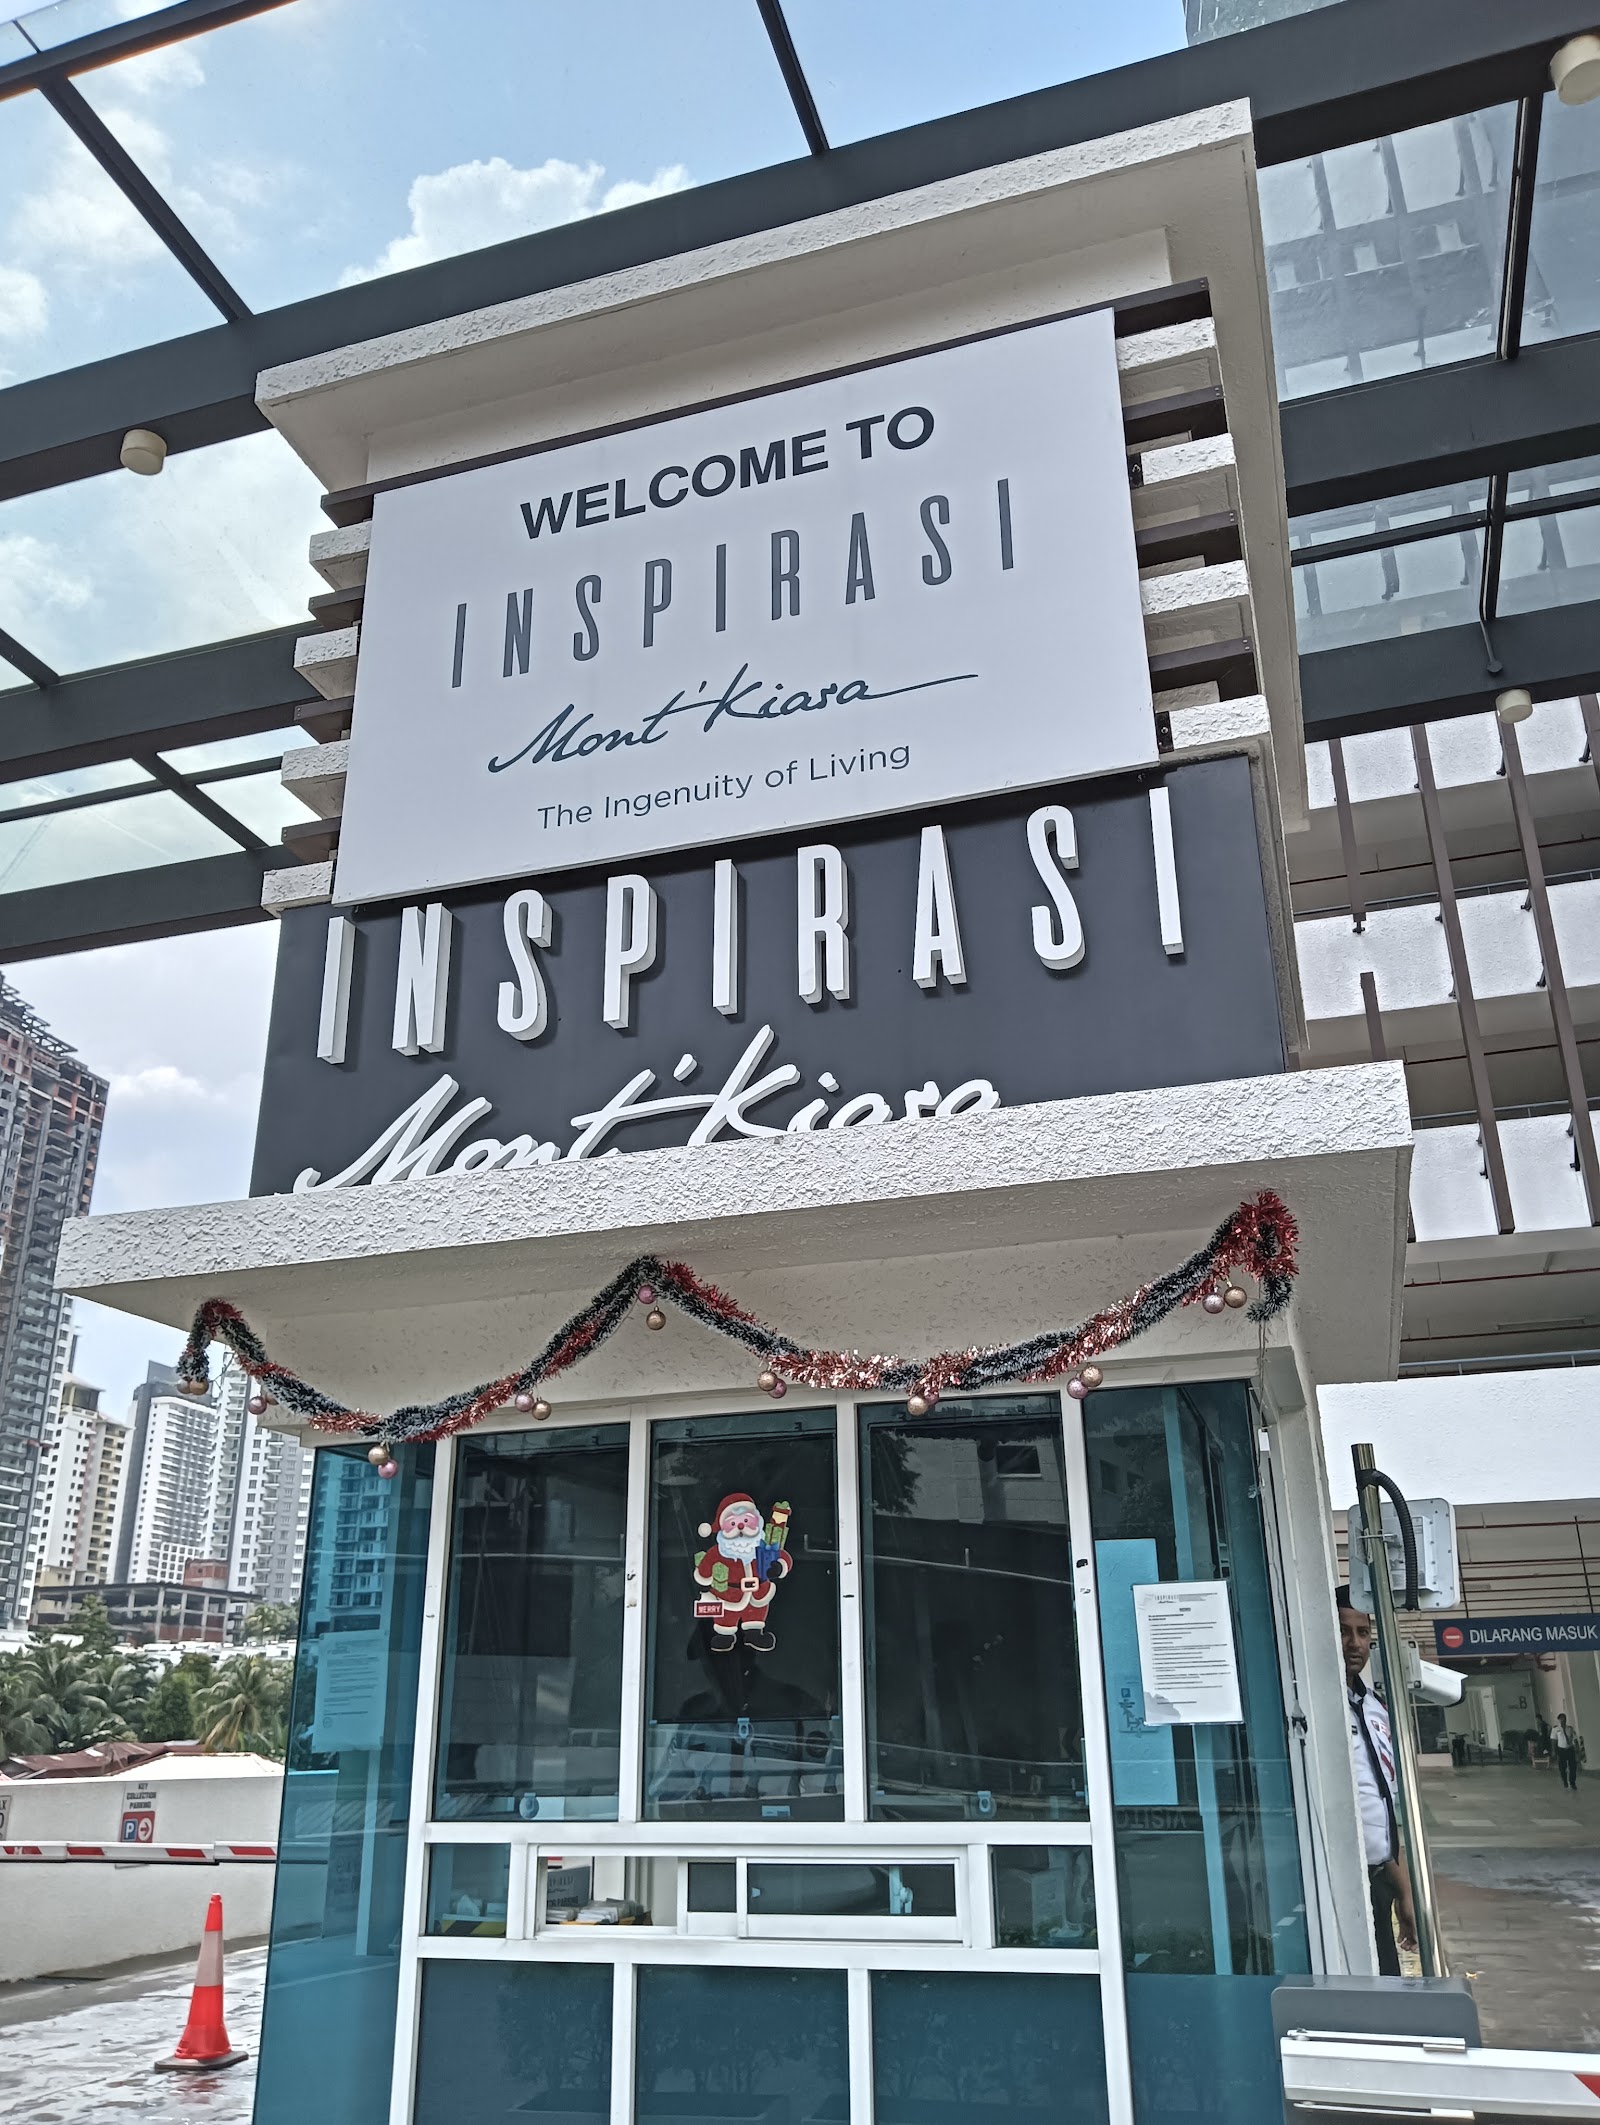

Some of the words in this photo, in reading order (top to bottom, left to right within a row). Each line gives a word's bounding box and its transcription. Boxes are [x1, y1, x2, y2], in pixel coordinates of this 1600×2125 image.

[519, 429, 829, 540] WELCOME
[845, 406, 935, 460] TO
[451, 477, 1015, 689] INSPIRASI
[537, 805, 593, 830] The
[605, 771, 754, 818] Ingenuity
[765, 760, 799, 788] of
[809, 743, 911, 782] Living
[315, 786, 1185, 1065] INSPIRASI
[698, 1605, 720, 1613] MERRY
[1469, 1627, 1543, 1644] DILARANG
[1545, 1624, 1599, 1641] MASUK
[126, 1791, 157, 1800] COLLECTION
[129, 1801, 152, 1809] PARKING
[125, 1822, 135, 1839] P
